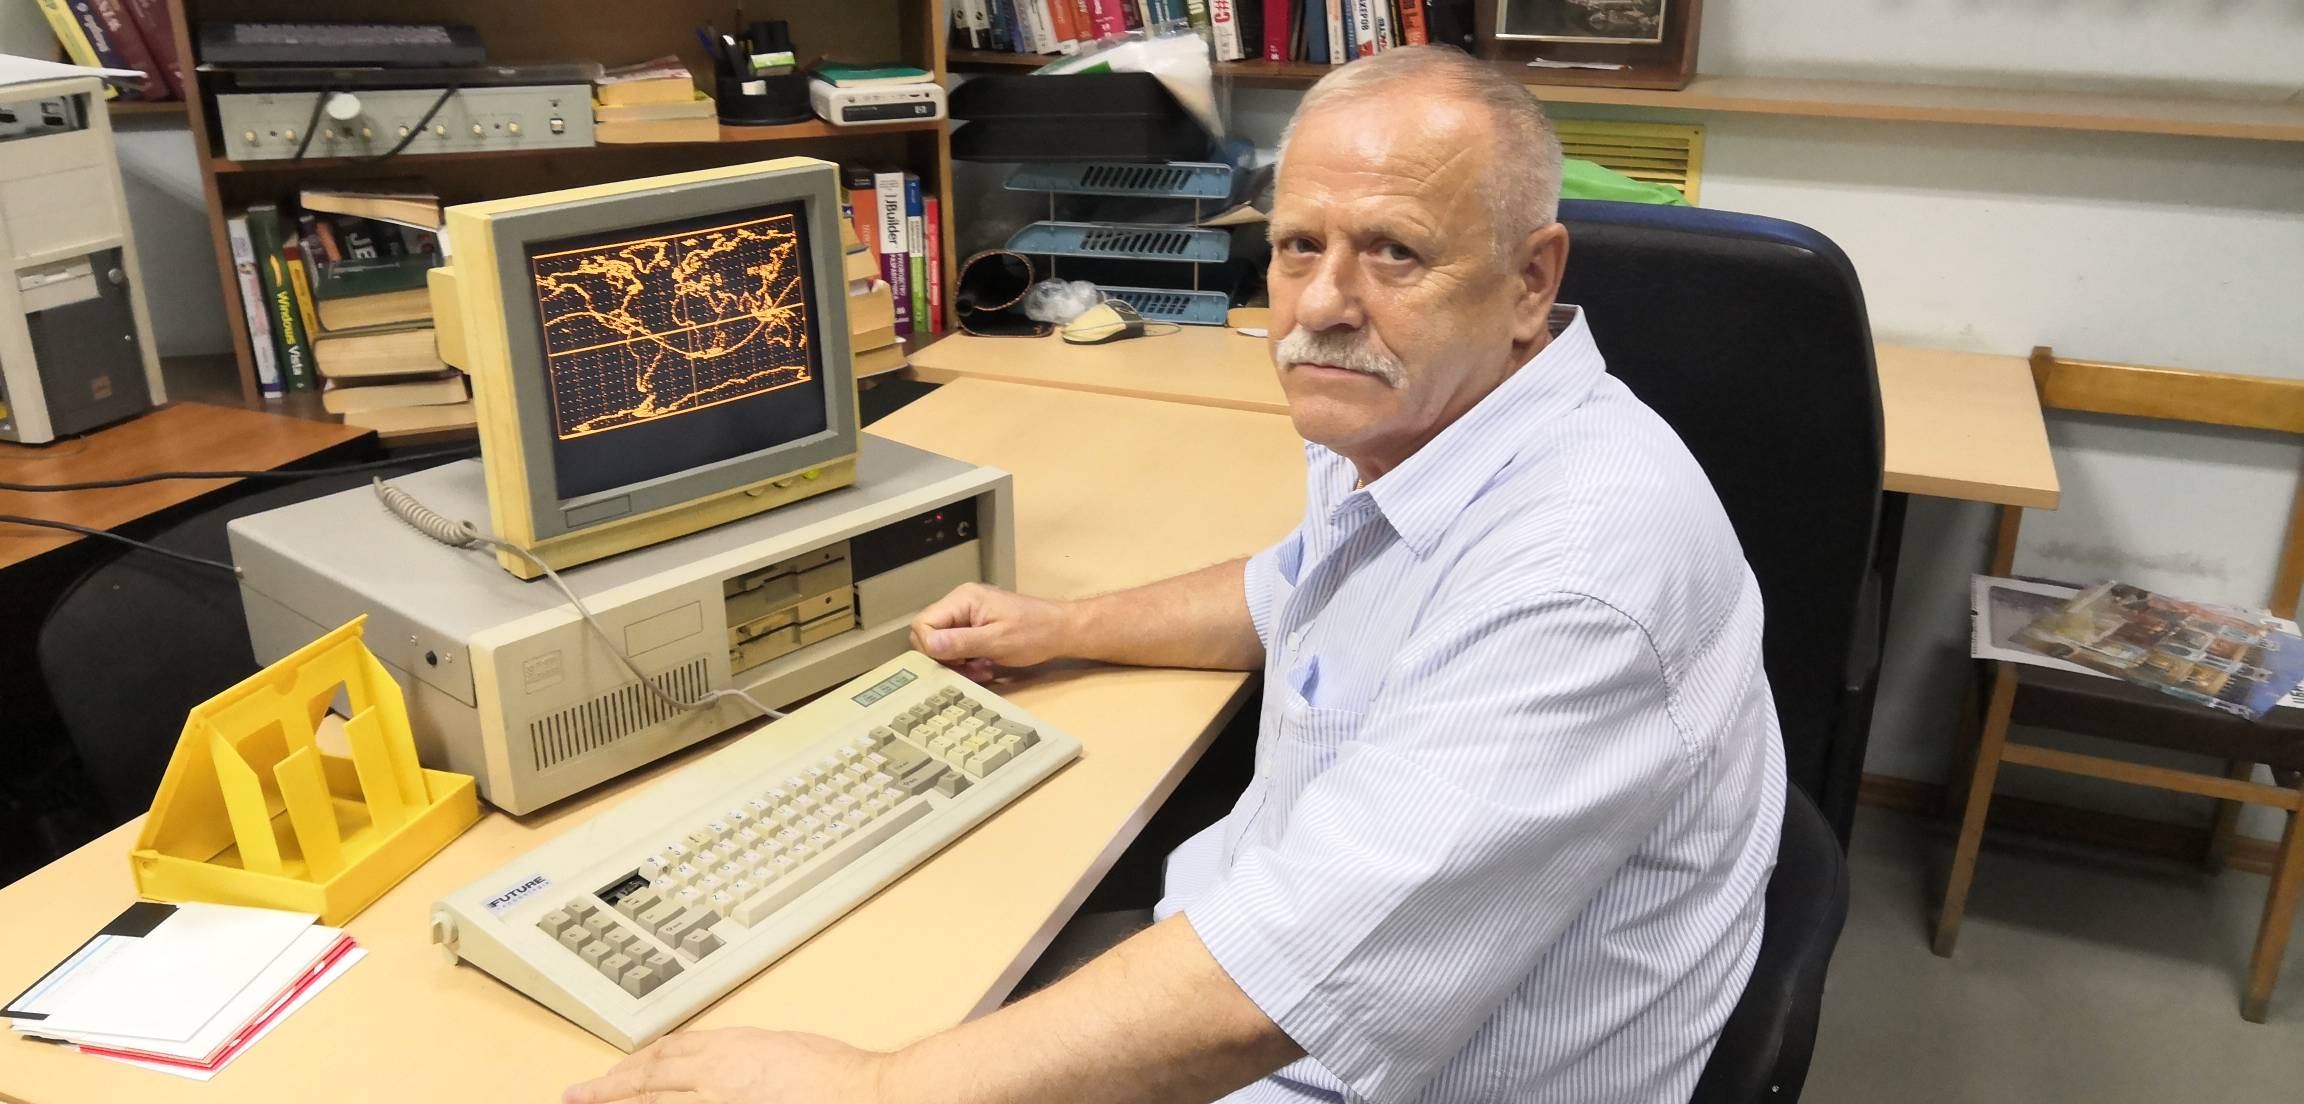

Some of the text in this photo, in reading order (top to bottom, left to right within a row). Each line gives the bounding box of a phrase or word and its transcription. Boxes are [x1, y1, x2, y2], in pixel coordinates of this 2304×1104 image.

[886, 200, 900, 244] JBuilder
[277, 291, 303, 375] Windows Vista
[488, 876, 545, 908] FUTURE
